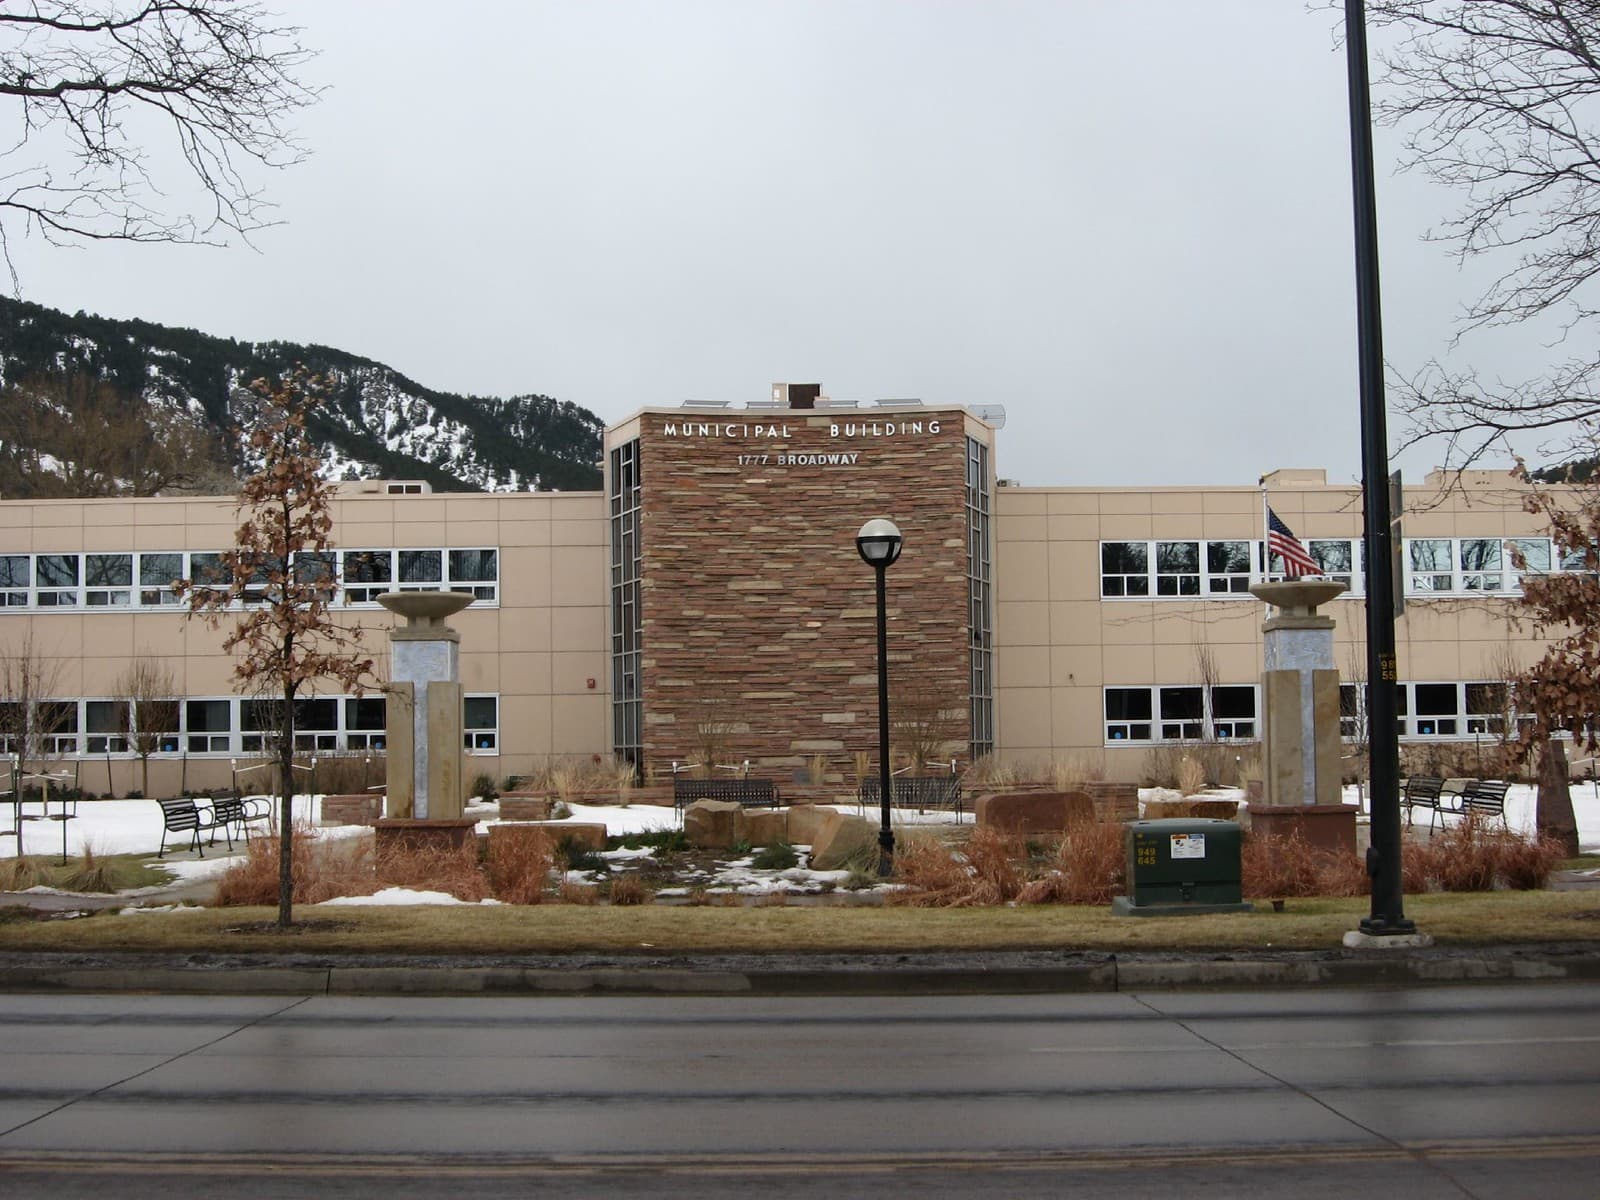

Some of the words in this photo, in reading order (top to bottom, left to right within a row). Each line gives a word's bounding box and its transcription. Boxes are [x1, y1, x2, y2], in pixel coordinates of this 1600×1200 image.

[664, 423, 792, 437] MUNICIPAL
[830, 421, 941, 437] BUILDING
[737, 455, 768, 465] 1777
[777, 454, 859, 465] BROADWAY
